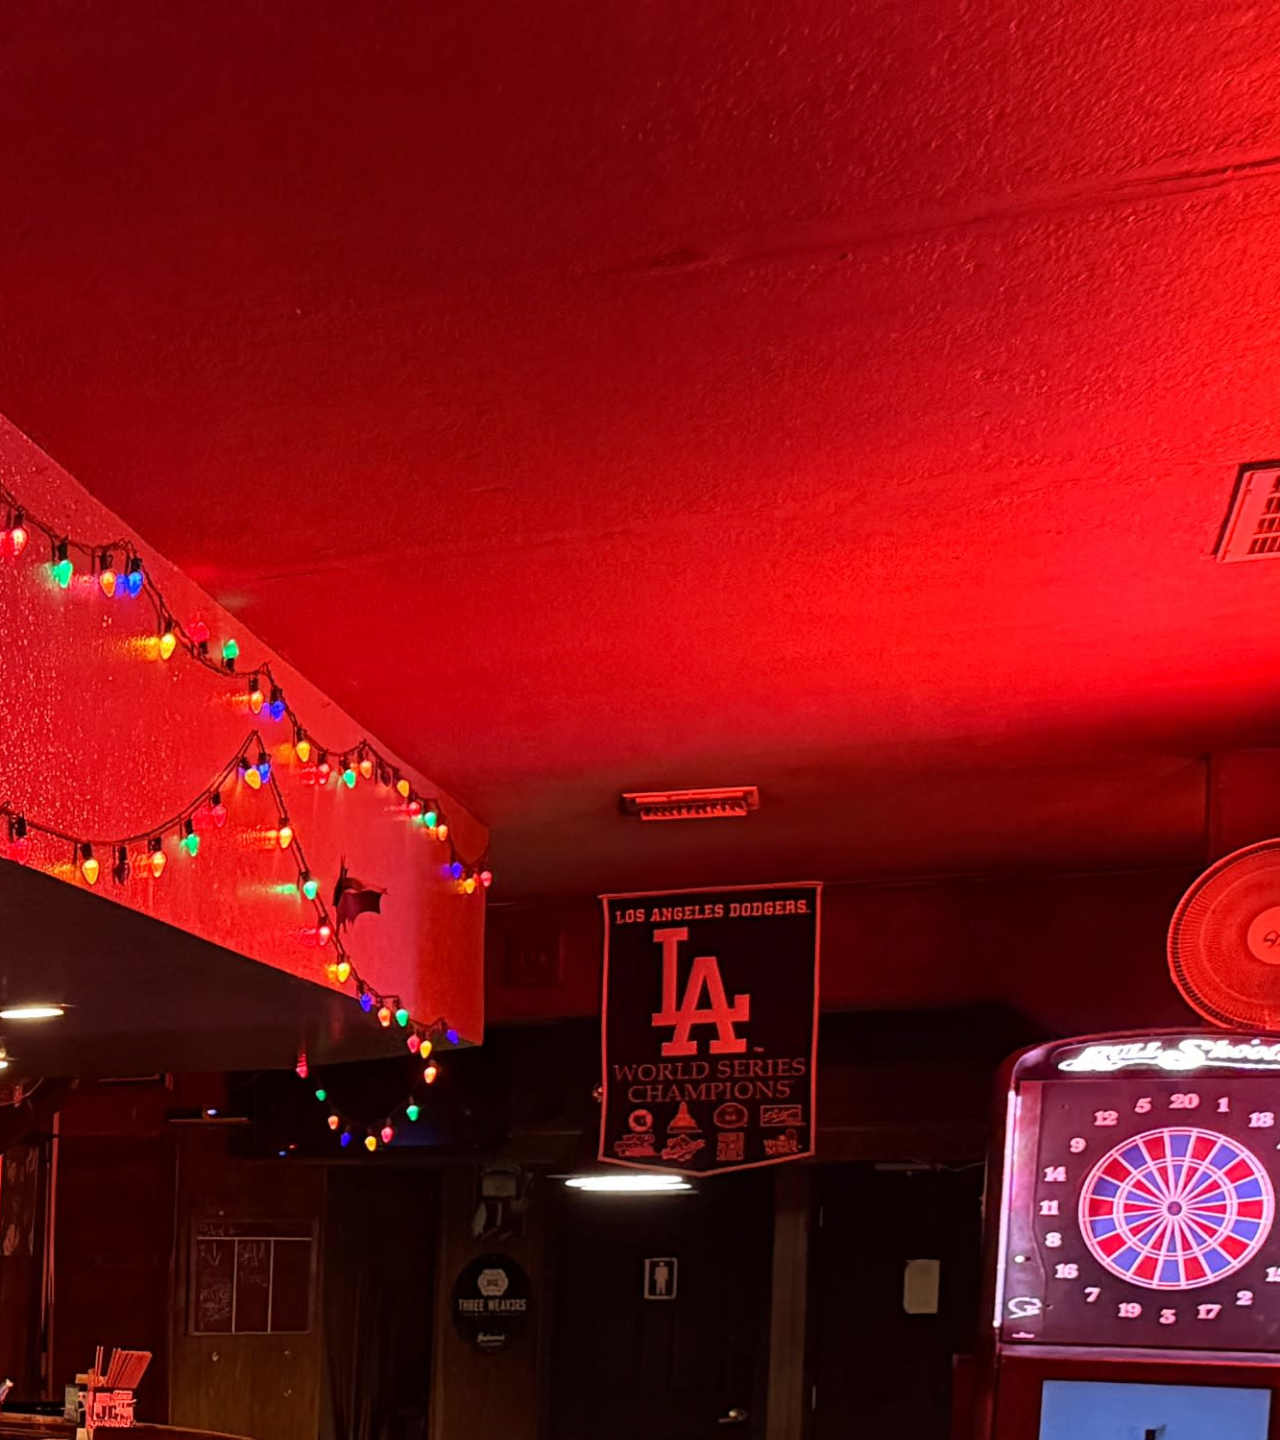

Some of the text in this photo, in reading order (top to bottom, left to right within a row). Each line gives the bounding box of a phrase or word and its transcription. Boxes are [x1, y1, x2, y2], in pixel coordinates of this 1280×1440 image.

[615, 900, 808, 924] LOS ANGELES DODGERS
[652, 927, 750, 1057] LA
[613, 1058, 806, 1082] WORLD SERIES
[627, 1080, 792, 1103] CHAMPIONS
[1135, 1098, 1152, 1113] 5
[1169, 1093, 1200, 1109] 20
[1217, 1097, 1230, 1112] 1
[1094, 1110, 1119, 1126] 12
[1248, 1112, 1275, 1127] 18
[1070, 1137, 1086, 1153] 9
[1044, 1166, 1067, 1182] 14
[1040, 1200, 1059, 1215] 11
[1045, 1232, 1062, 1247] 8
[1055, 1264, 1079, 1279] 16
[1084, 1286, 1101, 1303] 7
[1237, 1291, 1253, 1306] 2
[1118, 1303, 1142, 1318] 19
[1159, 1309, 1177, 1324] 3
[1197, 1304, 1222, 1320] 17
